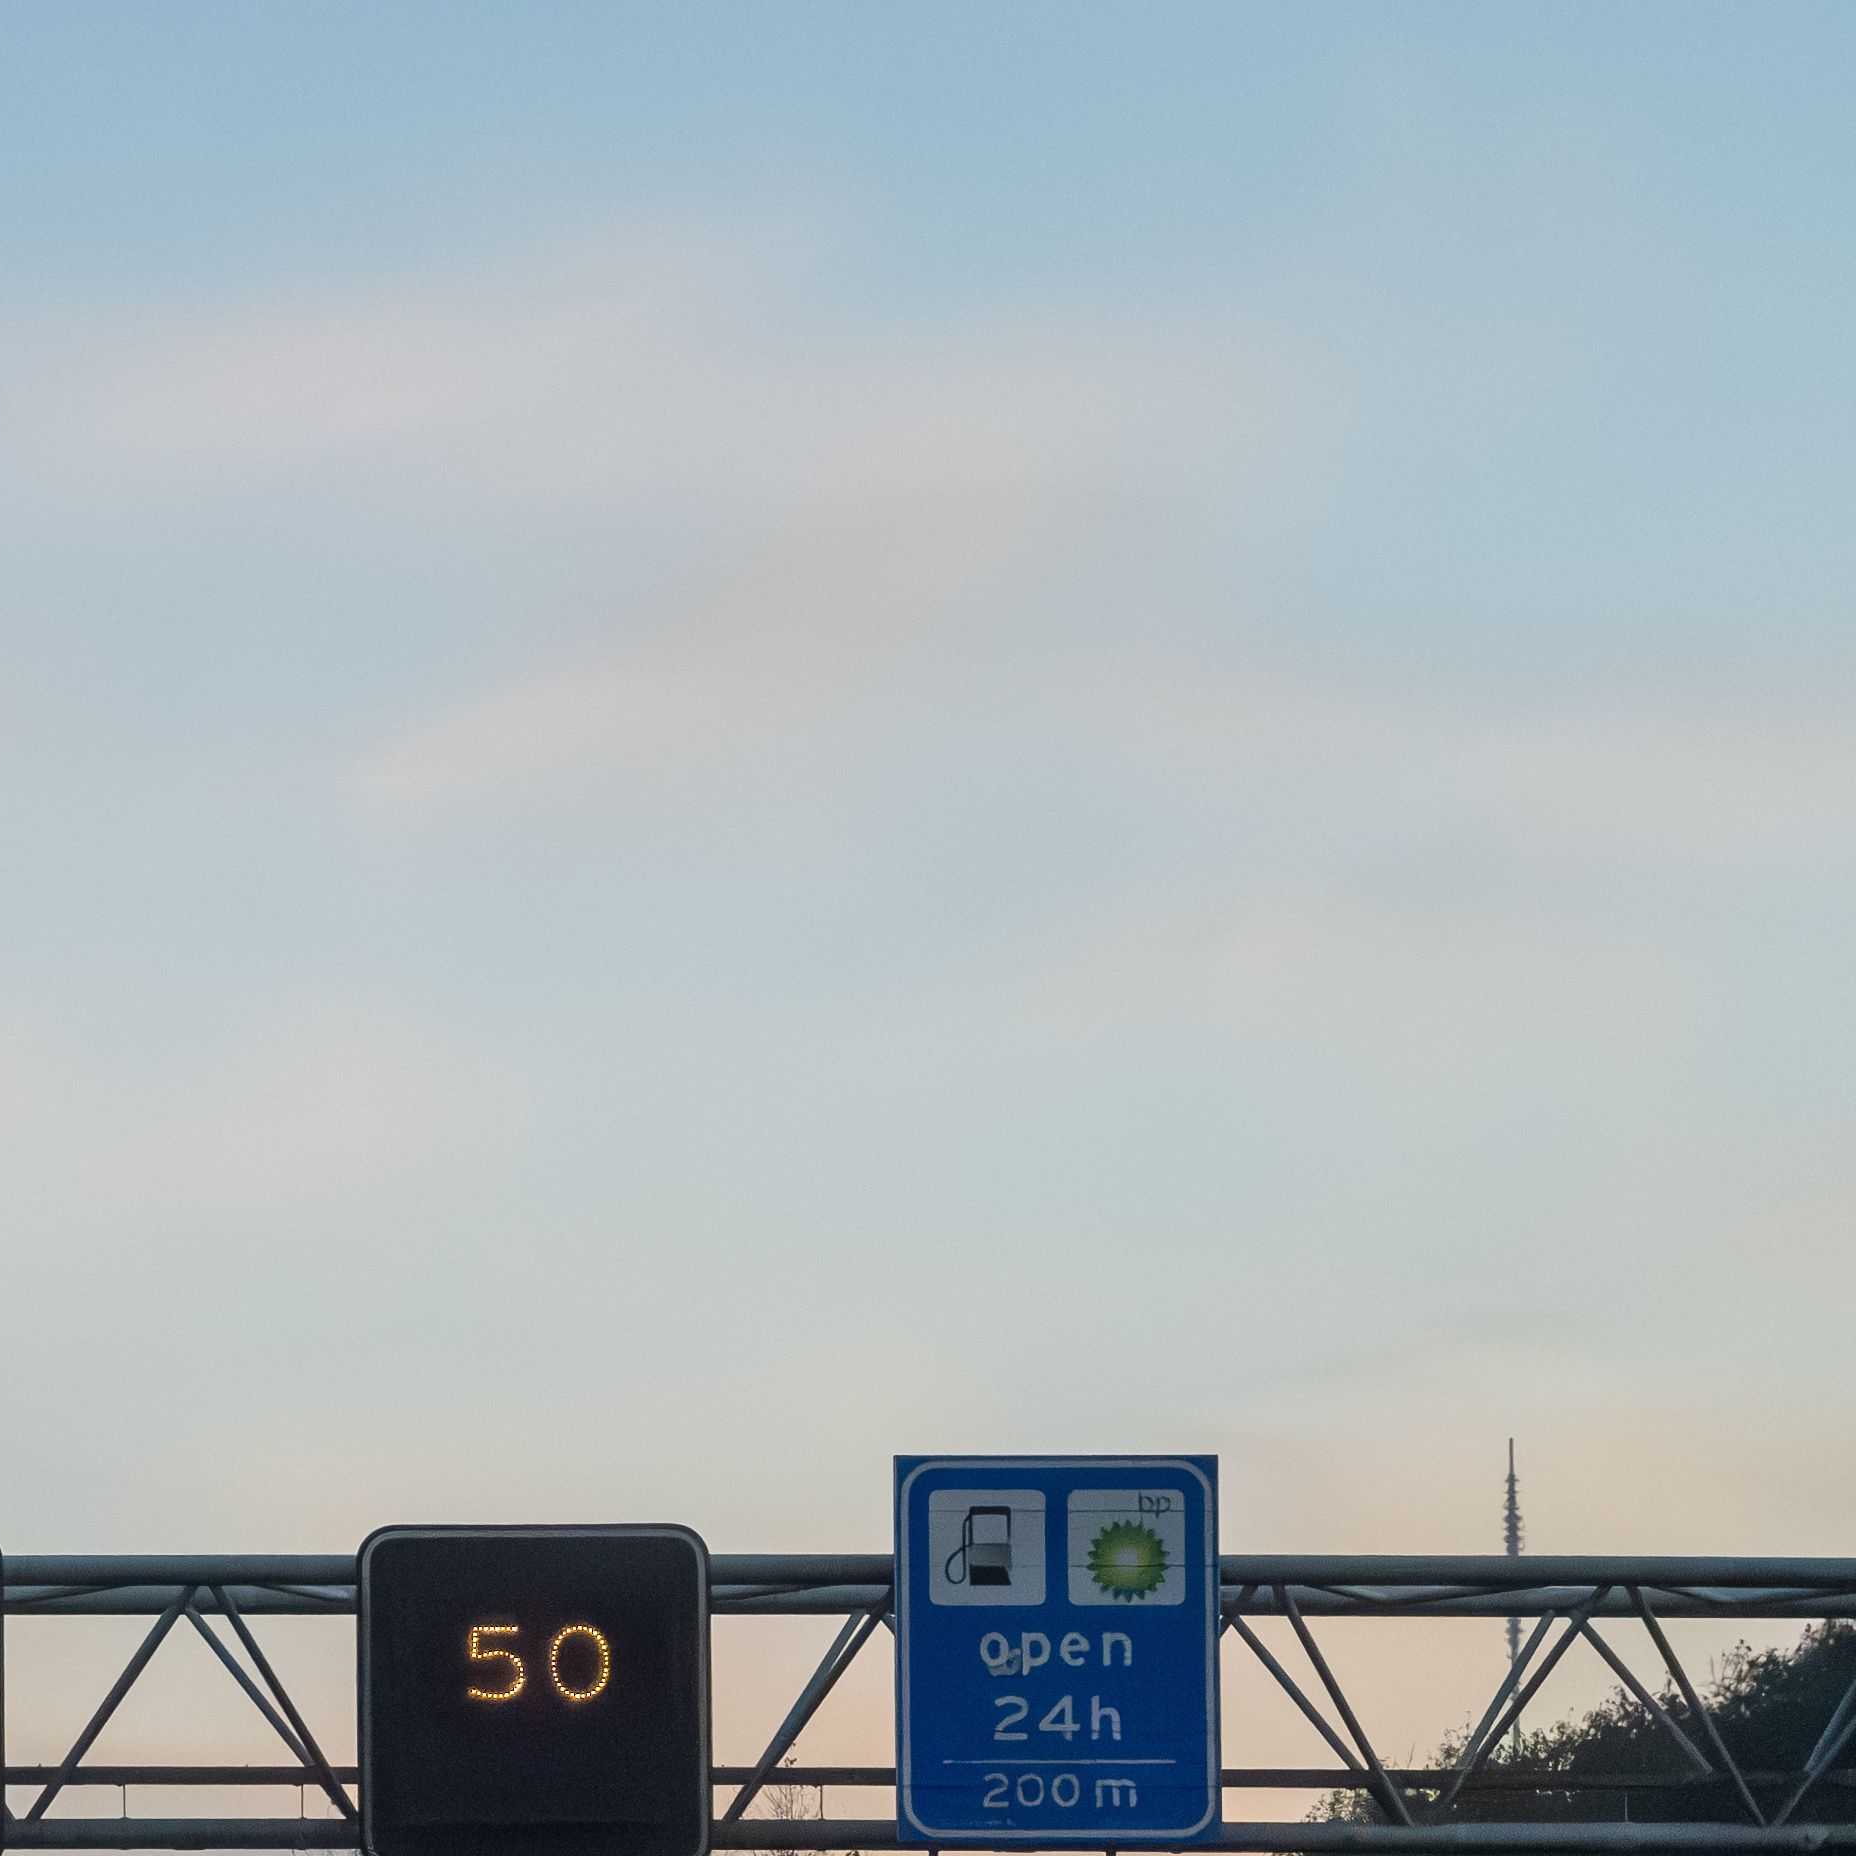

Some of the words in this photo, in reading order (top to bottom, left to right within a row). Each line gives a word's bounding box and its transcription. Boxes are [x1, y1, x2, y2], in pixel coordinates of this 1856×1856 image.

[1138, 1493, 1172, 1517] bp
[466, 1624, 611, 1702] 50
[979, 1630, 1134, 1678] open
[993, 1694, 1123, 1742] 24h
[982, 1772, 1081, 1809] 200
[1095, 1776, 1138, 1809] m
